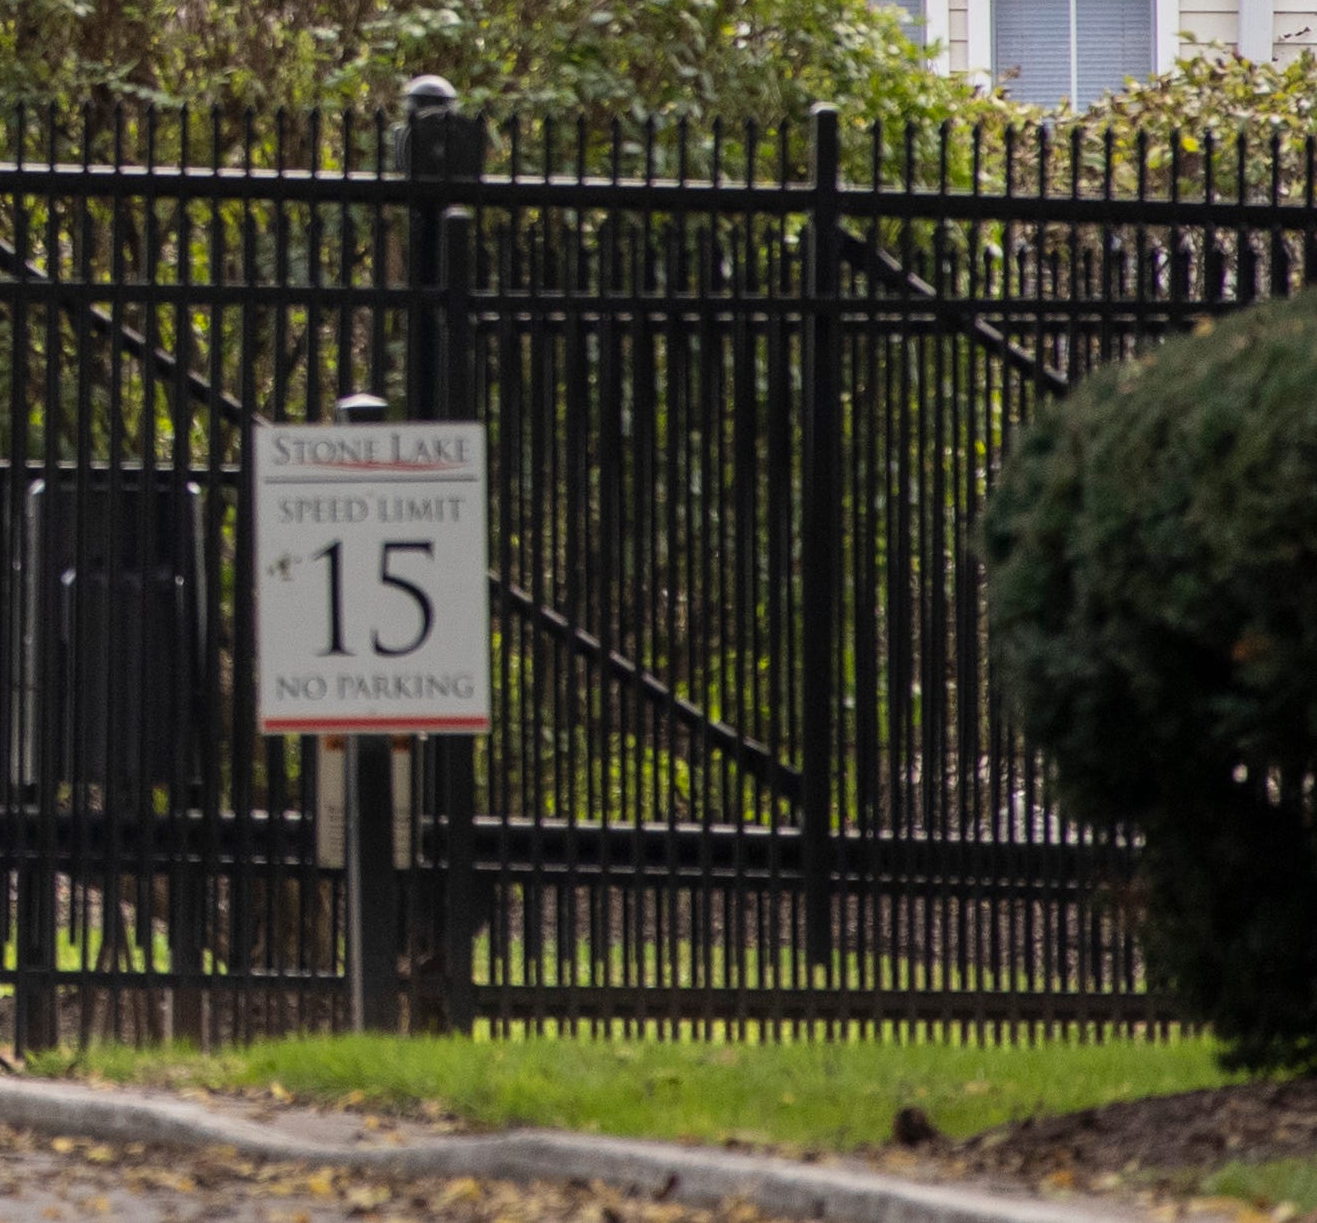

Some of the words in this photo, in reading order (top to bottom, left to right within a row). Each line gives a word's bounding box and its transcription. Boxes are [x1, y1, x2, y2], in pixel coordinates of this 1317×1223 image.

[272, 433, 381, 466] STONE
[390, 432, 470, 464] LAKE
[277, 495, 367, 524] SPEED
[377, 495, 466, 523] LIMIT
[312, 537, 436, 658] 15
[275, 673, 328, 702] NO
[336, 672, 475, 701] PARKING
